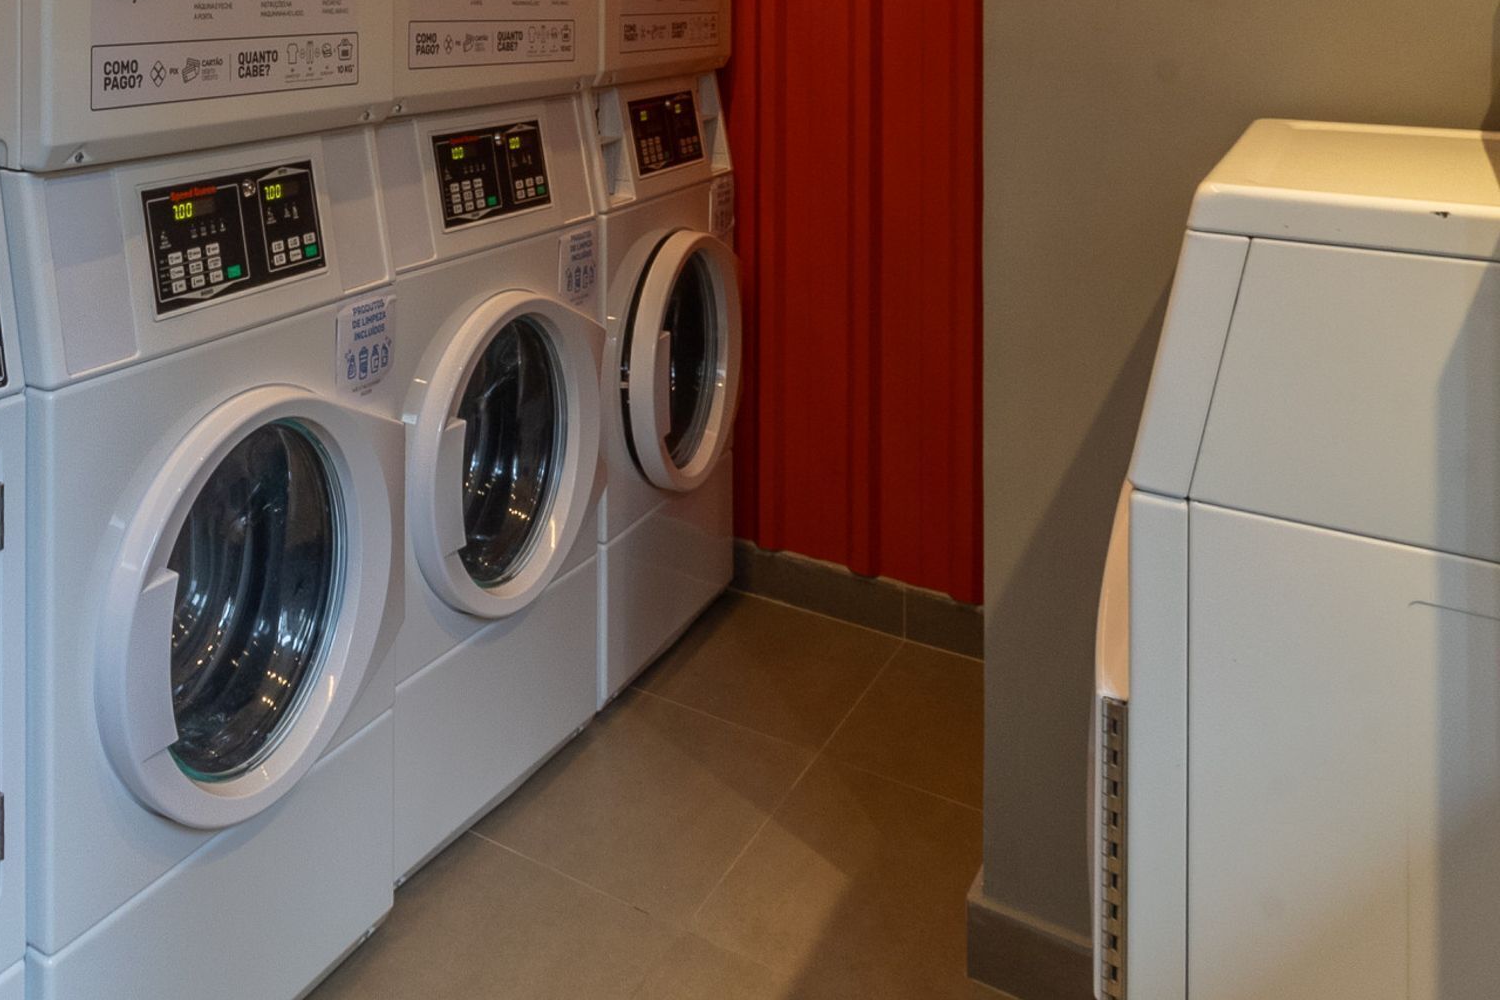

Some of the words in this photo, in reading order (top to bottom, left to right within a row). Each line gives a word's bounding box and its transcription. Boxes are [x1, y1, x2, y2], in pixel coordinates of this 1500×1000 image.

[415, 32, 437, 44] COMO
[238, 50, 278, 66] QUANTO
[103, 59, 139, 76] COMO
[238, 64, 271, 78] CABE?
[103, 74, 143, 91] PAGO?
